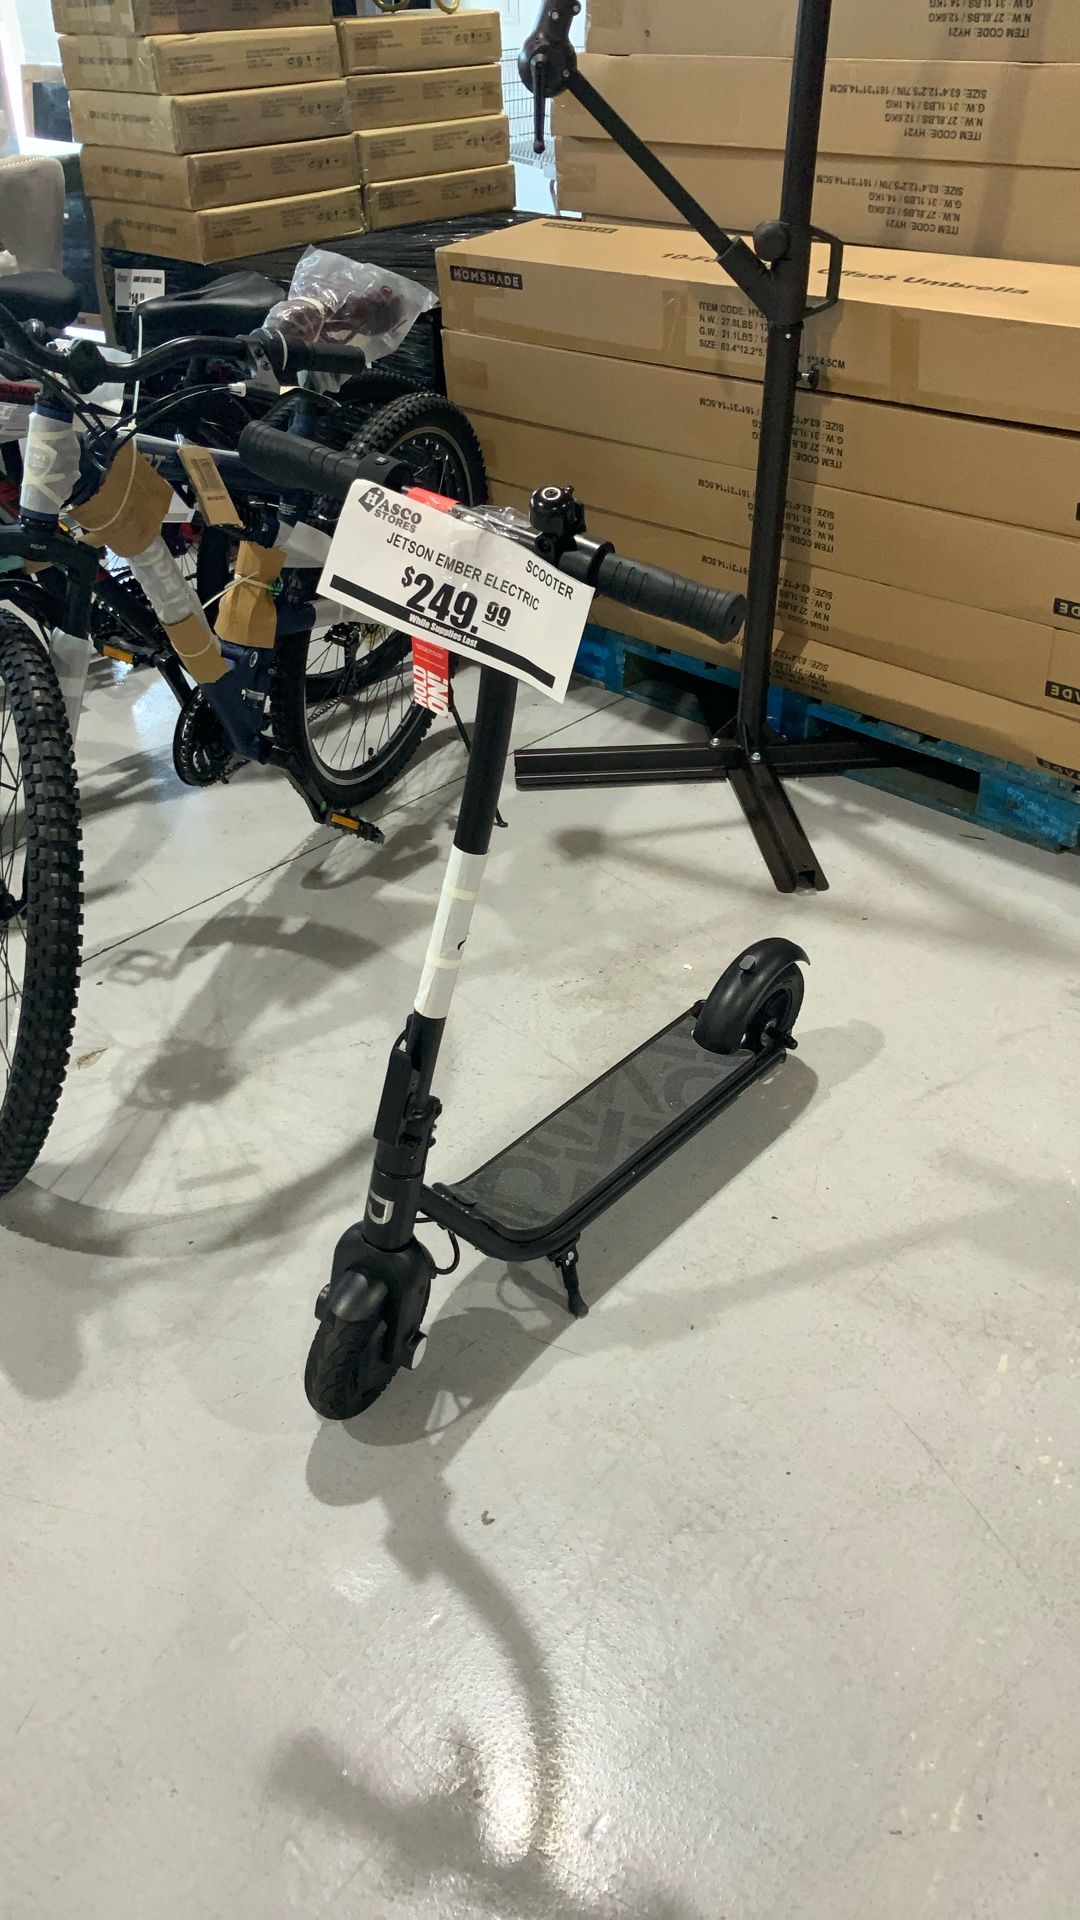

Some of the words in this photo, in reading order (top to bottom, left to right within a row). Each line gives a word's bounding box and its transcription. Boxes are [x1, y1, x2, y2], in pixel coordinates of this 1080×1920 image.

[948, 27, 971, 38] HY21
[1006, 27, 1030, 38] ITEM
[903, 128, 926, 138] HY21
[959, 130, 982, 141] ITEM
[885, 219, 906, 229] HY21
[937, 226, 959, 235] ITEM
[453, 267, 520, 288] HOMSHADE
[661, 252, 718, 263] 10-Fo
[903, 275, 1030, 296] Umbrella
[699, 301, 718, 312] ITEM
[822, 457, 842, 469] ITEM
[374, 508, 417, 533] STORES
[814, 542, 834, 554] ITEM
[386, 531, 435, 562] JETSON
[435, 552, 482, 583] EMBER
[484, 572, 541, 611] ELECTRIC
[525, 559, 575, 600] SCOOTER
[409, 613, 431, 631] While
[430, 620, 463, 643] Supplies
[461, 632, 478, 648] Last
[413, 664, 428, 708] HOLD
